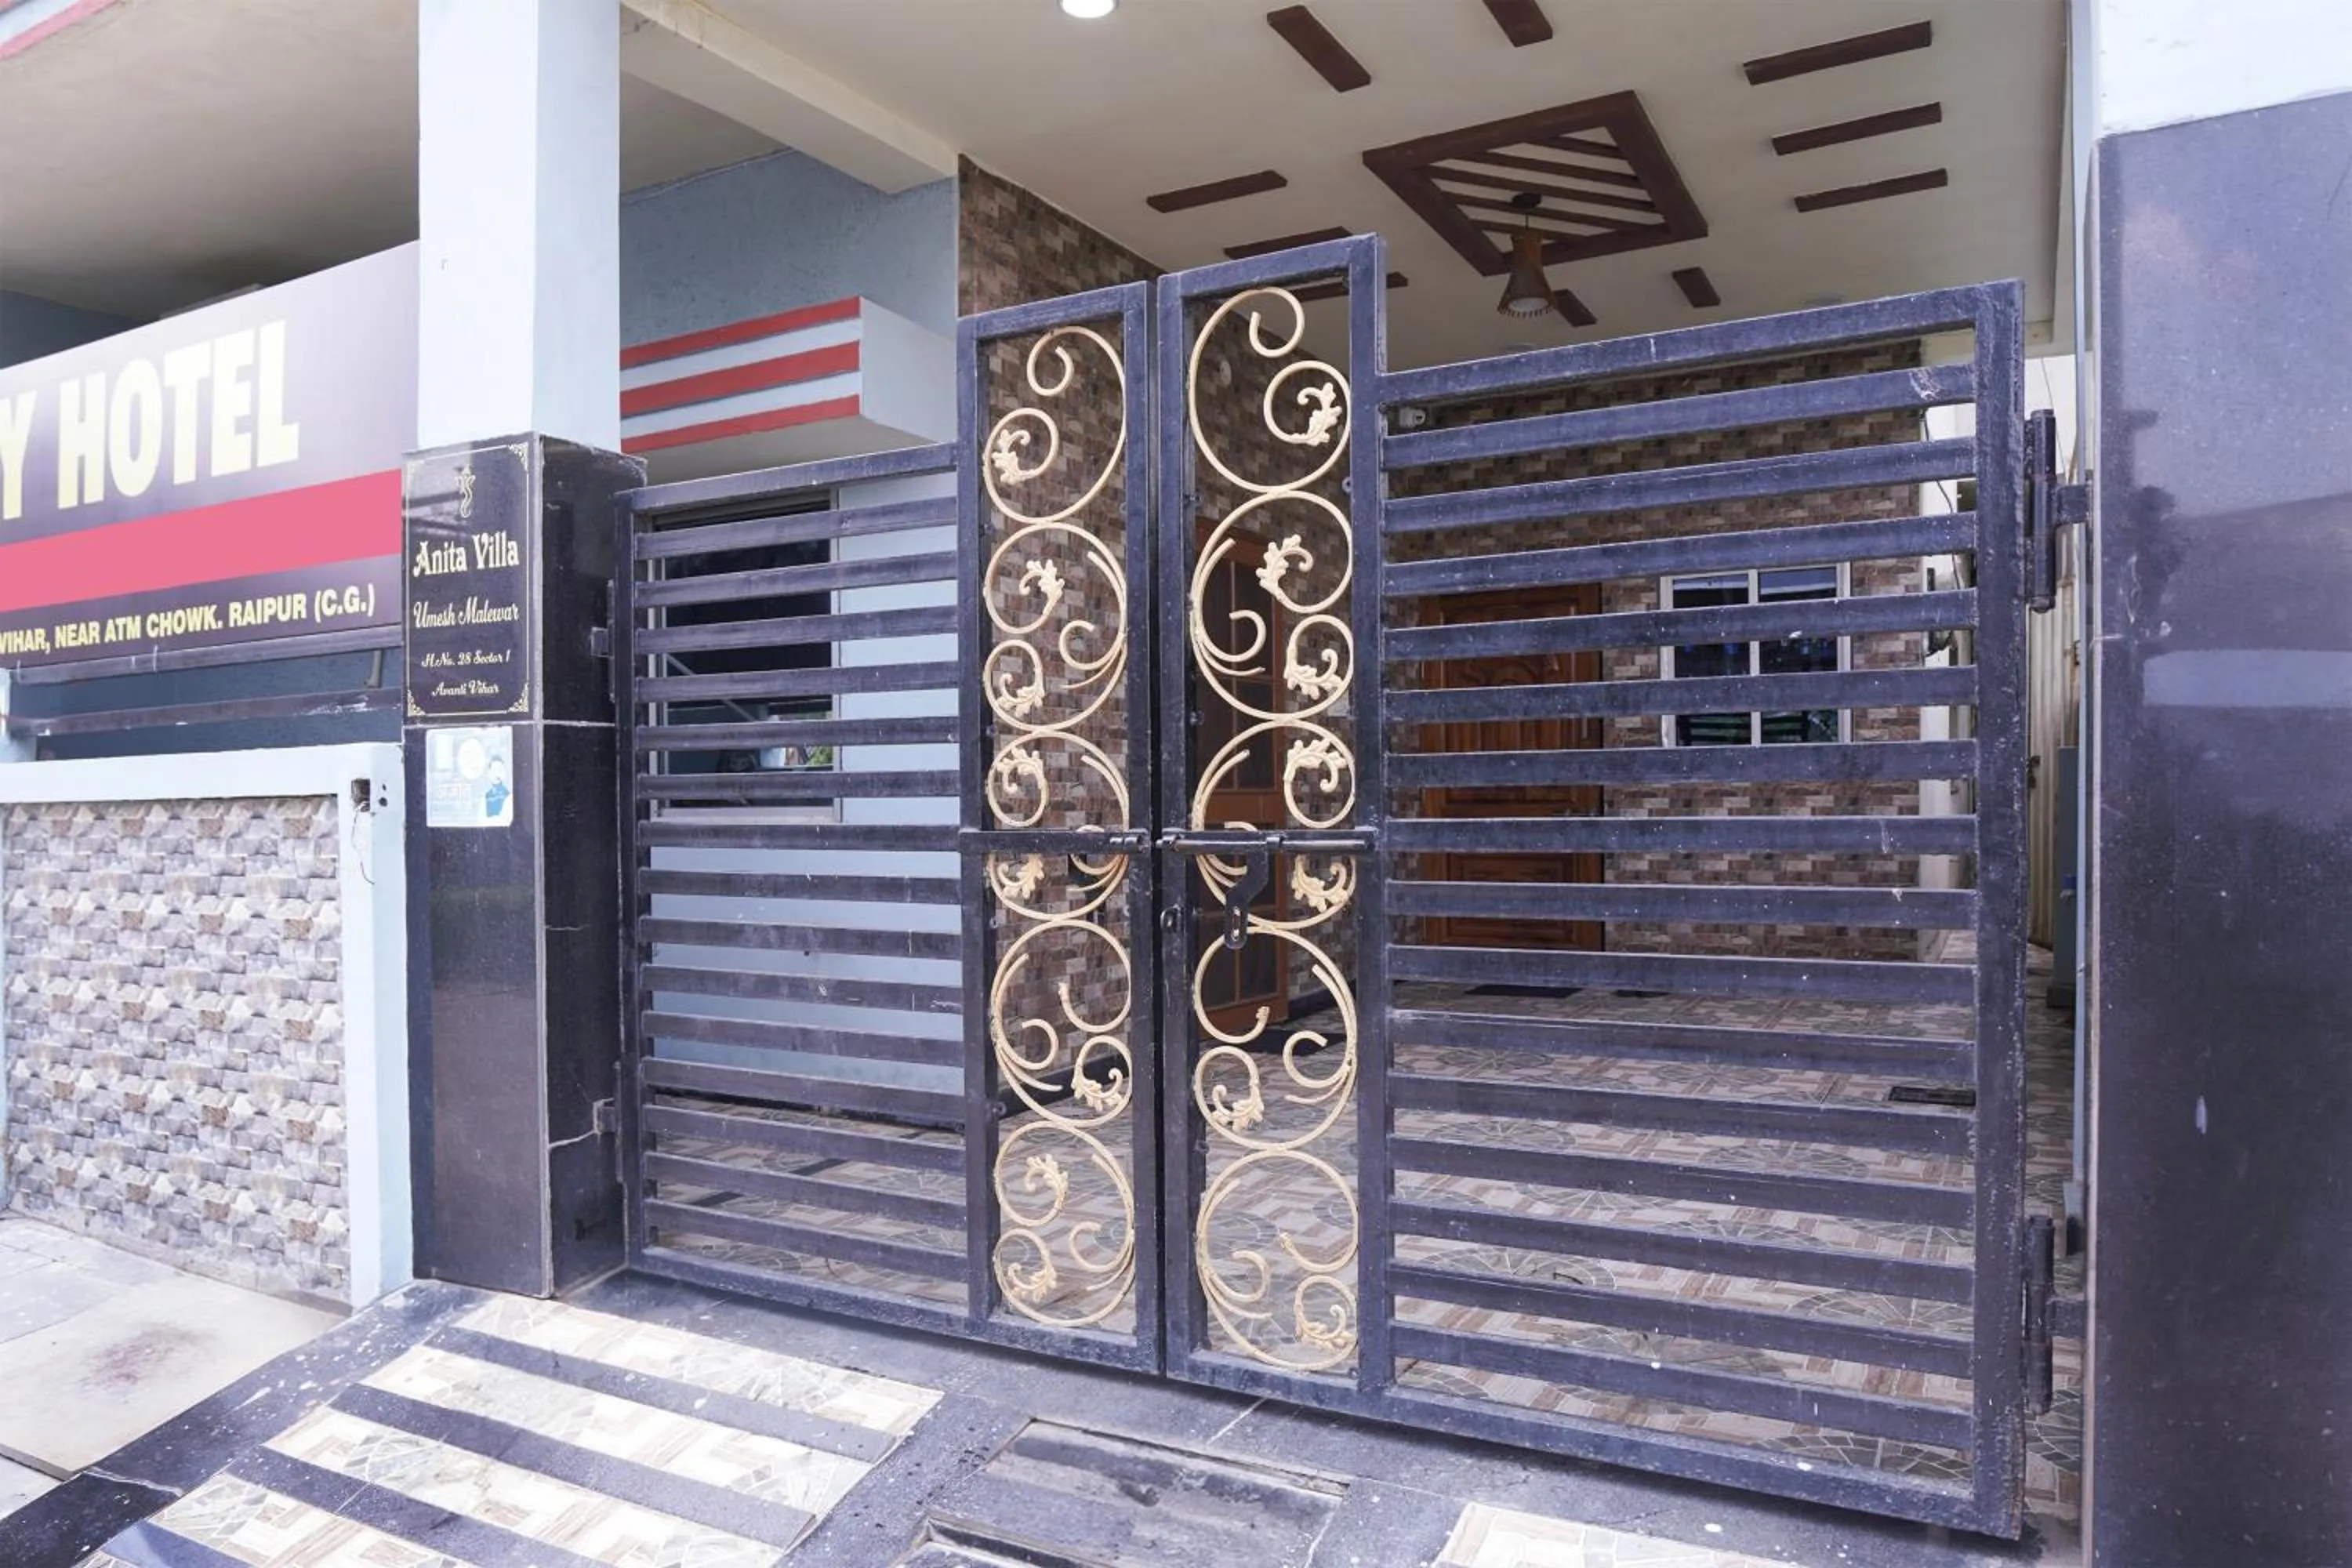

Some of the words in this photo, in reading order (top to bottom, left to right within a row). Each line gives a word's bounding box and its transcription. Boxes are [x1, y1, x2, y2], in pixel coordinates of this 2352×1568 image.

[0, 390, 37, 519] Y
[57, 319, 299, 510] HOTEL
[412, 540, 468, 577] Anita
[472, 530, 520, 570] Villa
[0, 628, 50, 655] VIHAR,
[55, 621, 100, 648] NEAR
[104, 615, 142, 643] ATM
[229, 593, 307, 627] RAIPUR
[314, 583, 375, 623] (C.G.)
[414, 601, 456, 628] Umesh
[458, 596, 519, 625] Malewar
[457, 652, 472, 666] 28
[473, 649, 503, 664] Sector
[468, 680, 499, 695] Vihar
